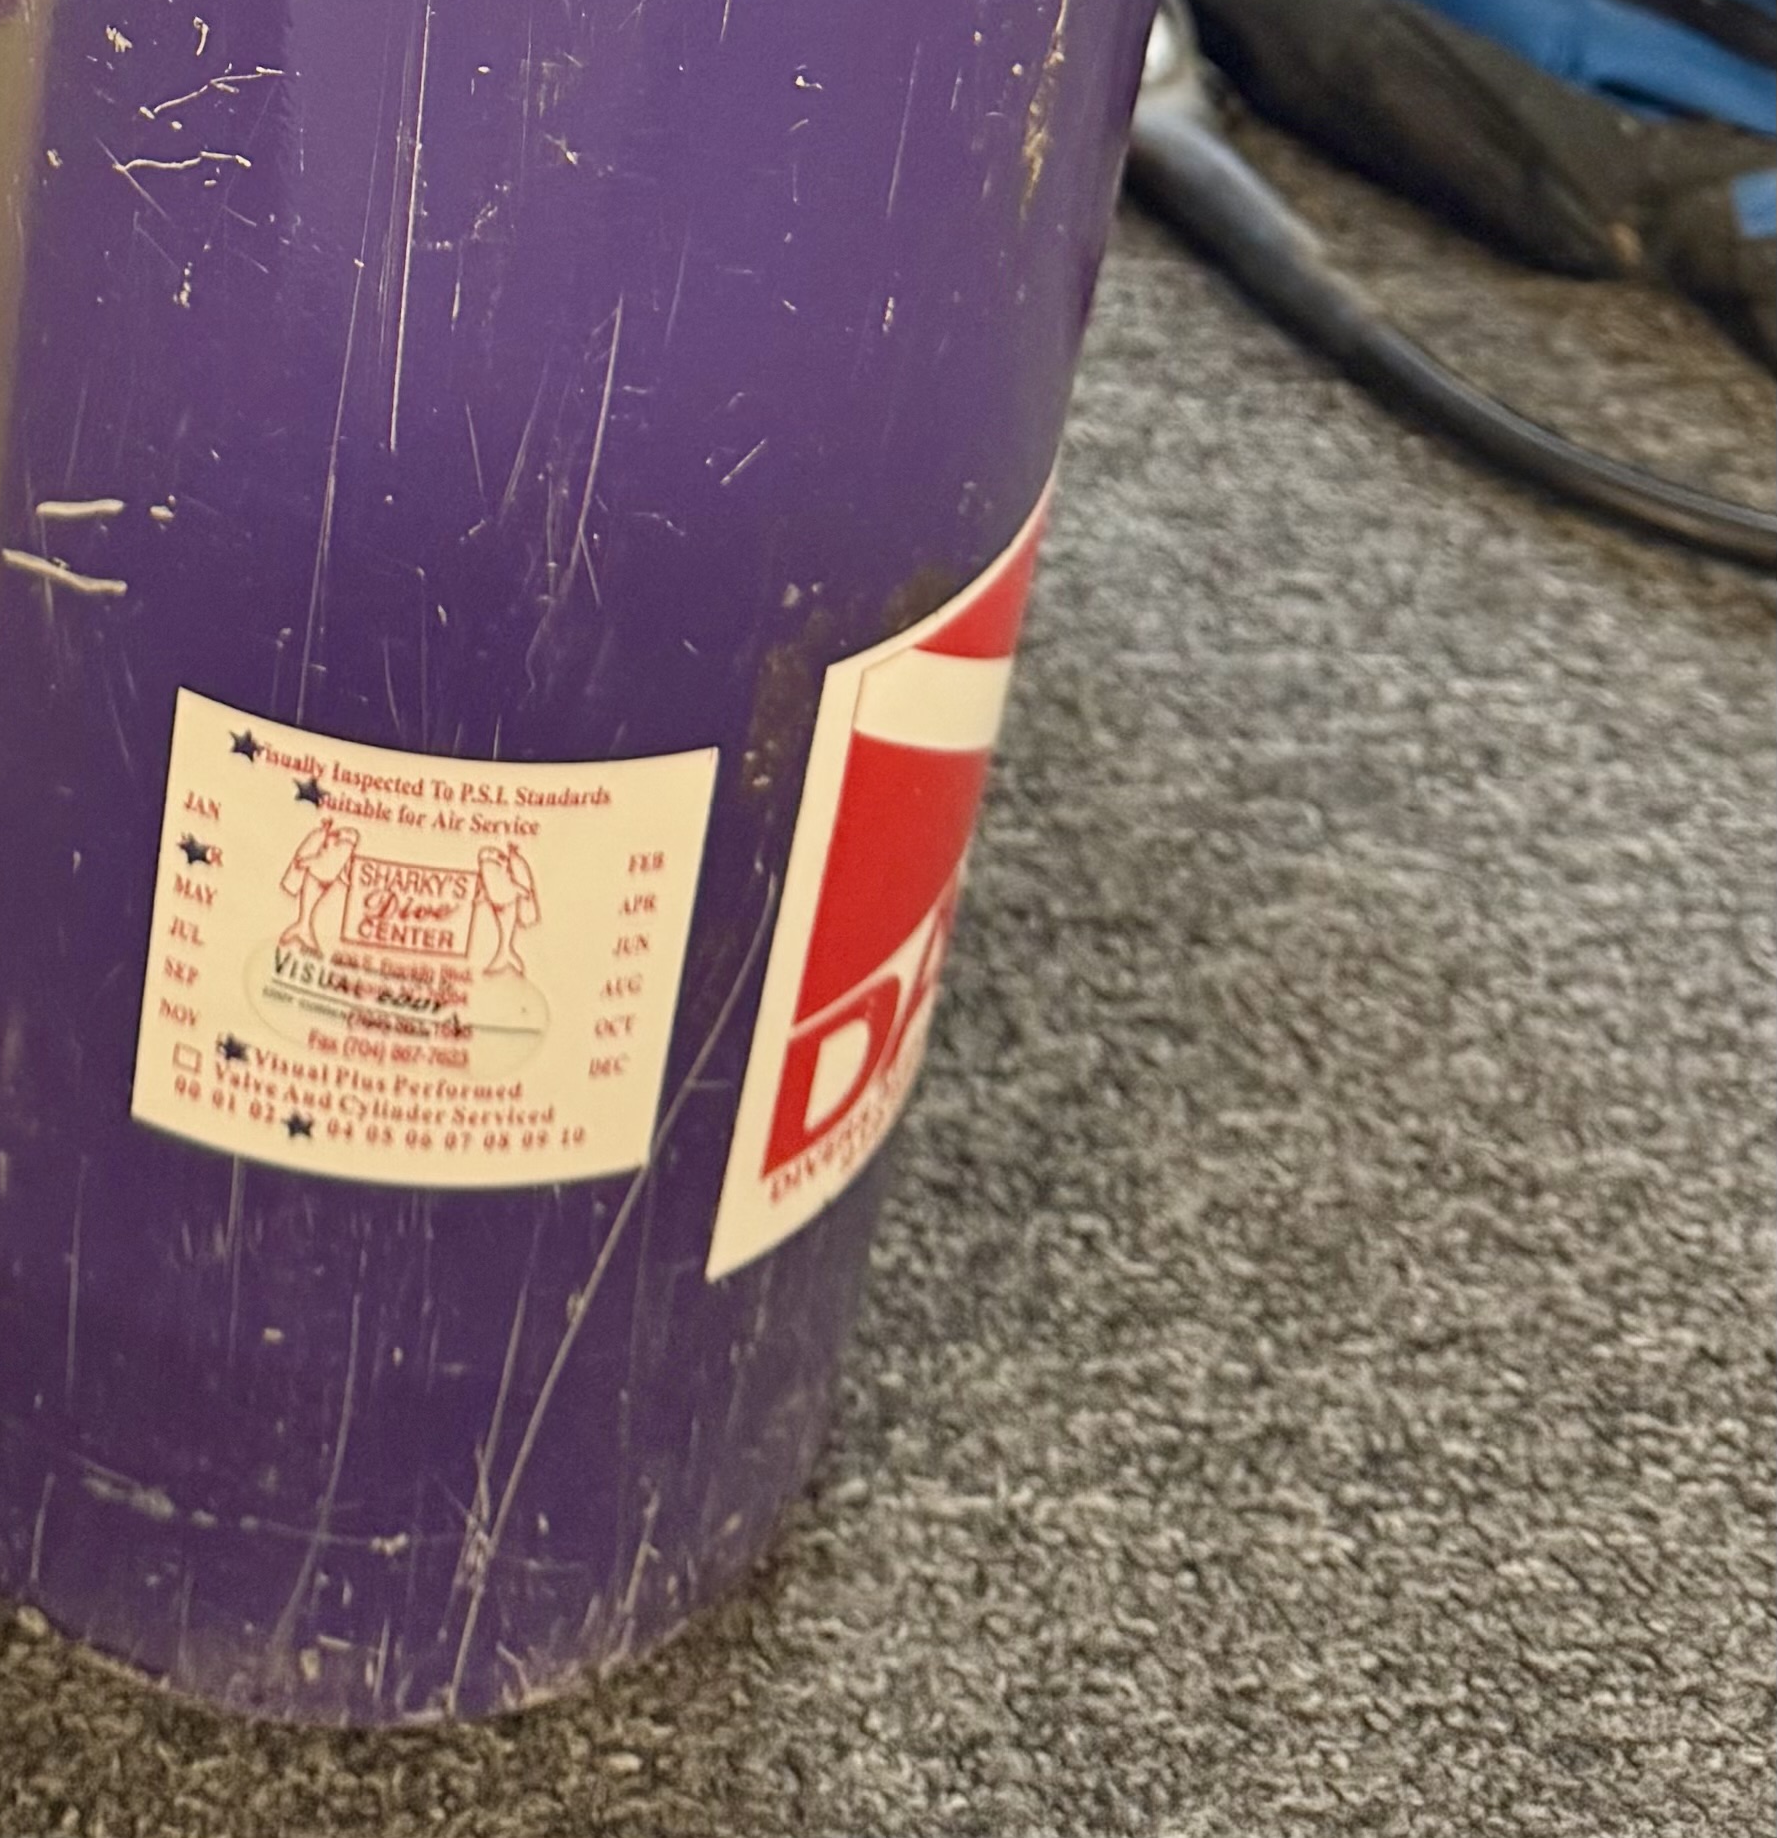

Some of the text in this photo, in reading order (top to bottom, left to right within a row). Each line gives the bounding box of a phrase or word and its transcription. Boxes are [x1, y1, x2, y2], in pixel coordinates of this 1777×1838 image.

[333, 761, 424, 793] Inspected
[432, 780, 455, 802] To
[461, 782, 509, 806] P.S.I.
[515, 786, 612, 808] Standards
[184, 790, 222, 821] JAN
[398, 805, 427, 828] for
[433, 811, 463, 831] Air
[470, 813, 540, 836] Service
[175, 874, 217, 907] MAY
[359, 862, 469, 900] SHARKY'S
[364, 890, 461, 920] Dive
[619, 894, 657, 916] APR
[170, 916, 203, 947] JUL
[358, 920, 454, 950] CENTER
[612, 934, 650, 958] JUN
[165, 956, 199, 986] SEP
[274, 944, 362, 1000] VISUAL
[600, 973, 643, 998] AUG
[160, 997, 197, 1026] NOV
[594, 1014, 637, 1038] OCT
[256, 1049, 523, 1101] Visual Plus Performed
[215, 1061, 555, 1126] Valve And Cylinder Serviced
[175, 1074, 201, 1102] 00
[212, 1088, 236, 1114] 01
[249, 1098, 276, 1125] 02
[444, 1130, 472, 1151] 07
[561, 1125, 585, 1147] 10
